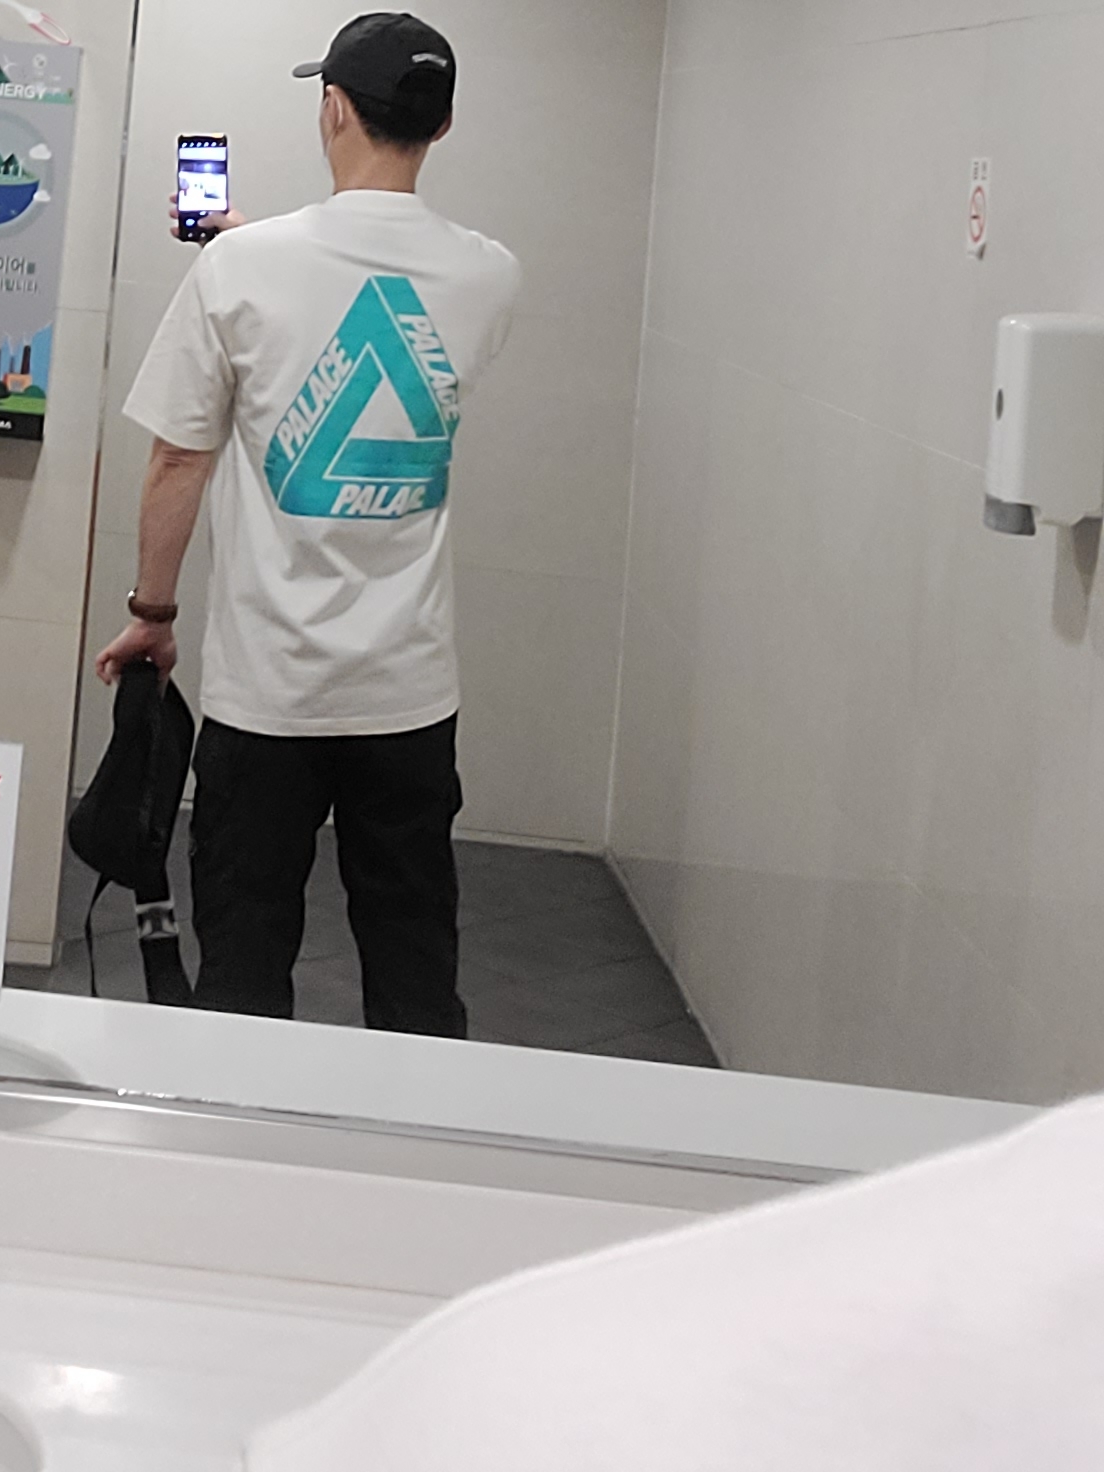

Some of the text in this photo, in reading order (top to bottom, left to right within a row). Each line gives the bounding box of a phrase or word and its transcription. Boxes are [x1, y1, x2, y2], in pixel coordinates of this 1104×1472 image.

[276, 334, 354, 462] PALACE
[396, 312, 460, 422] PALACE
[329, 483, 426, 516] PALAC
